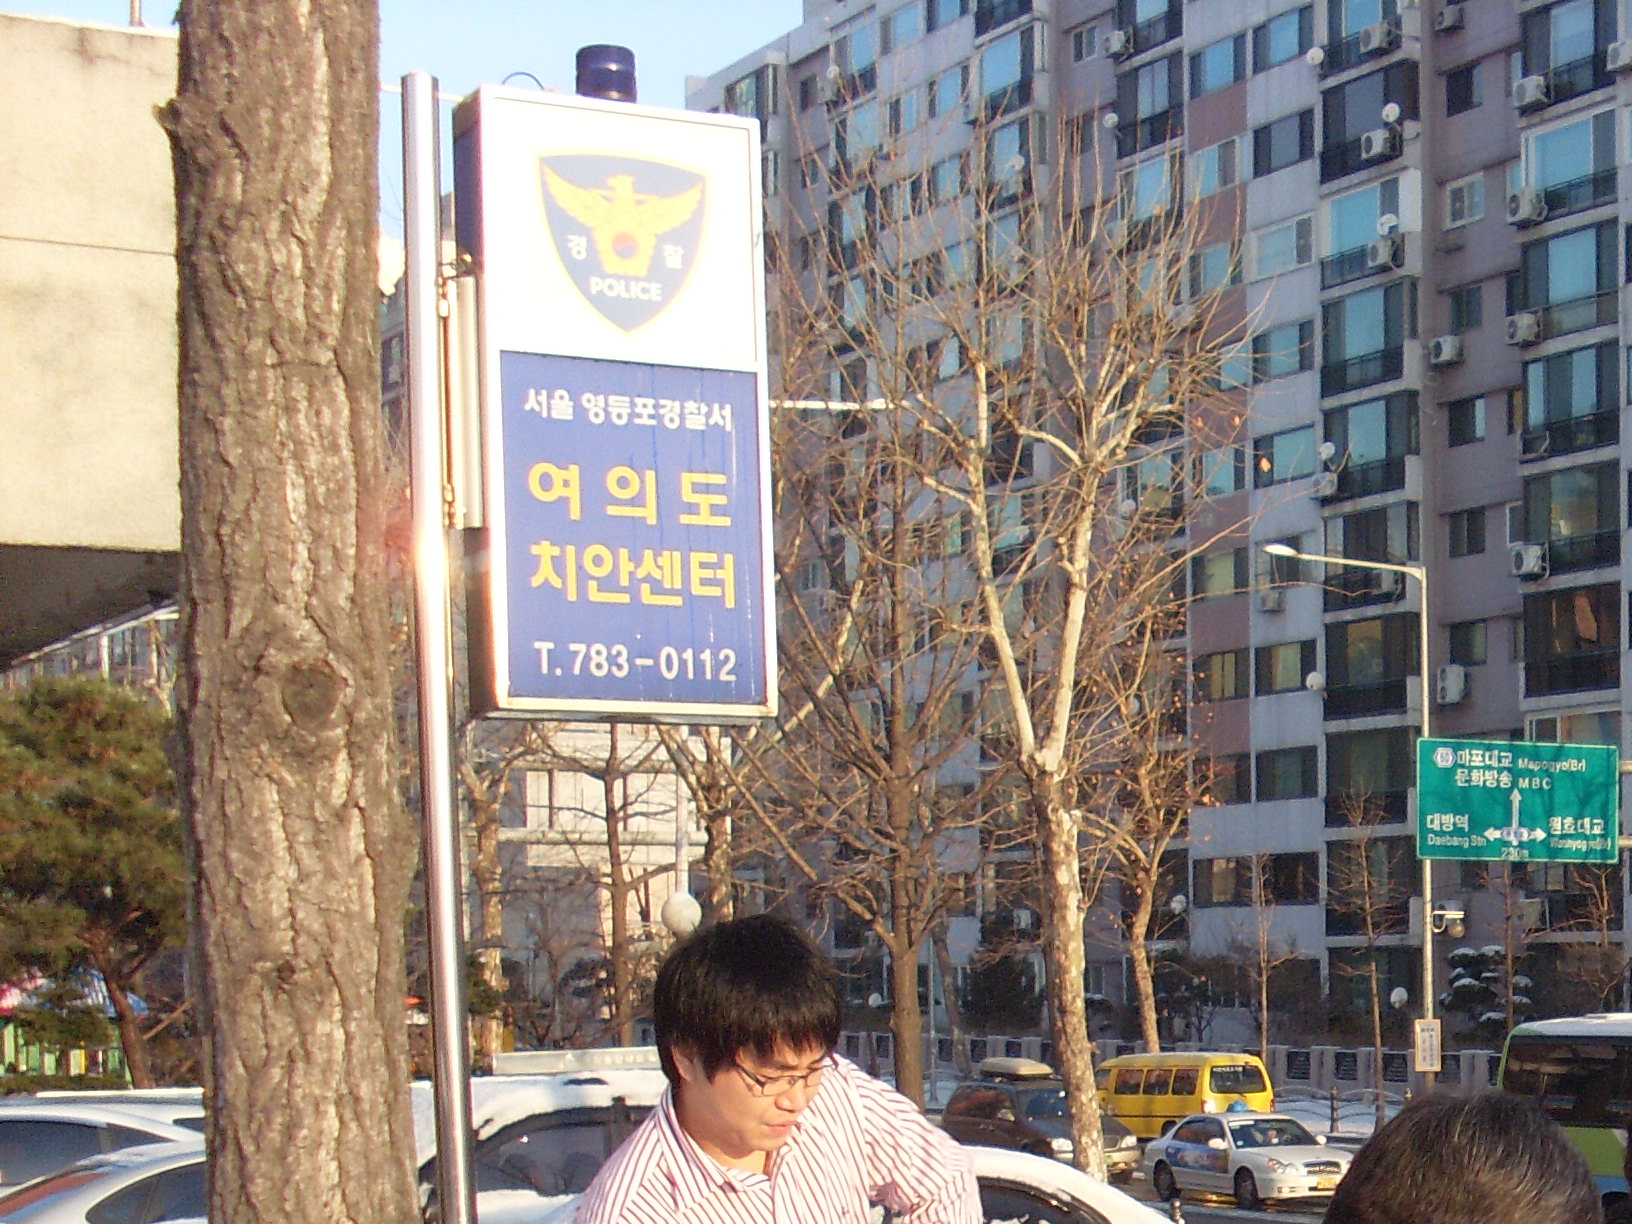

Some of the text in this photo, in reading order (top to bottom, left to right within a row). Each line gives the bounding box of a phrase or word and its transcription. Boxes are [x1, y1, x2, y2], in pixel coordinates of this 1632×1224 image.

[589, 275, 663, 302] POLICE
[524, 388, 733, 432] 서울 영등포경찰서
[530, 540, 737, 609] 치안센터
[1456, 749, 1514, 769] 마포대교
[1455, 768, 1513, 789] 문화방송
[1426, 812, 1469, 833] 대방역
[1427, 834, 1470, 849] Daebang
